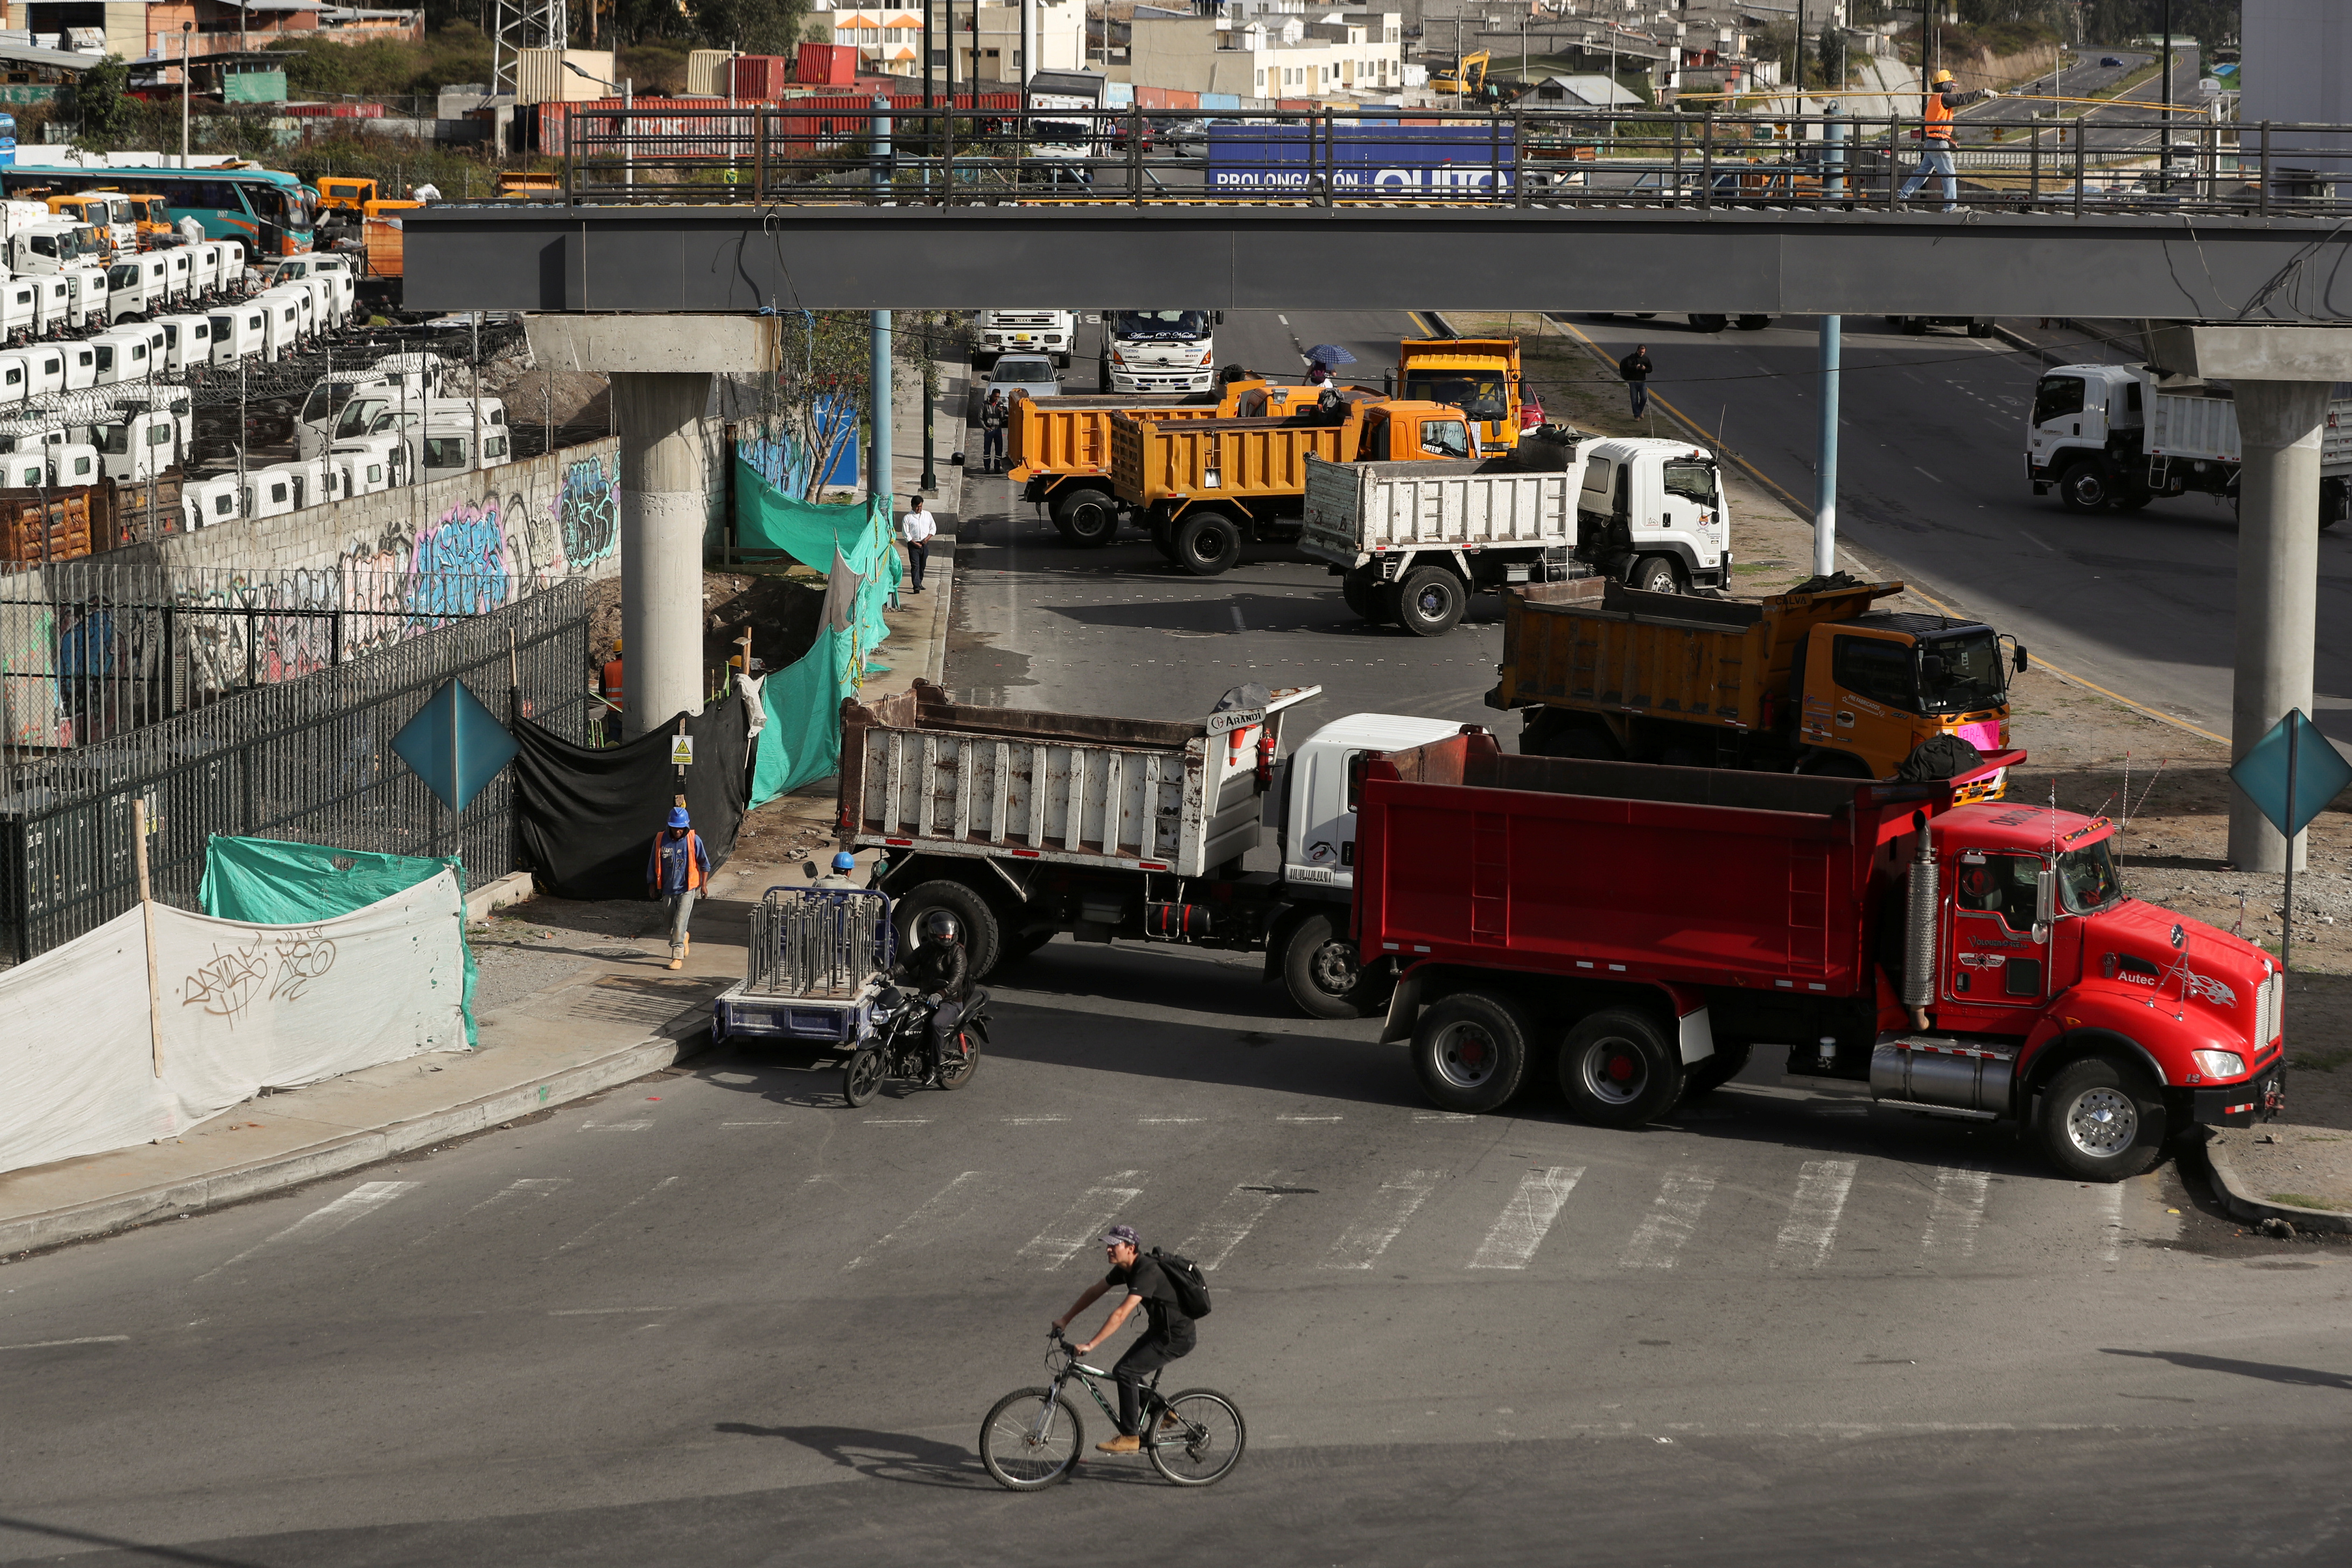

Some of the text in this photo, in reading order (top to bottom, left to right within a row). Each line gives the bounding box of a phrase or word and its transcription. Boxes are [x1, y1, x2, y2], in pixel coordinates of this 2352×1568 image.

[1128, 332, 1154, 340] Amor
[1775, 596, 1807, 605] CALVA
[1856, 696, 1880, 711] FABRICADOS
[1295, 875, 1325, 883] LORENA
[2117, 971, 2155, 986] Autec
